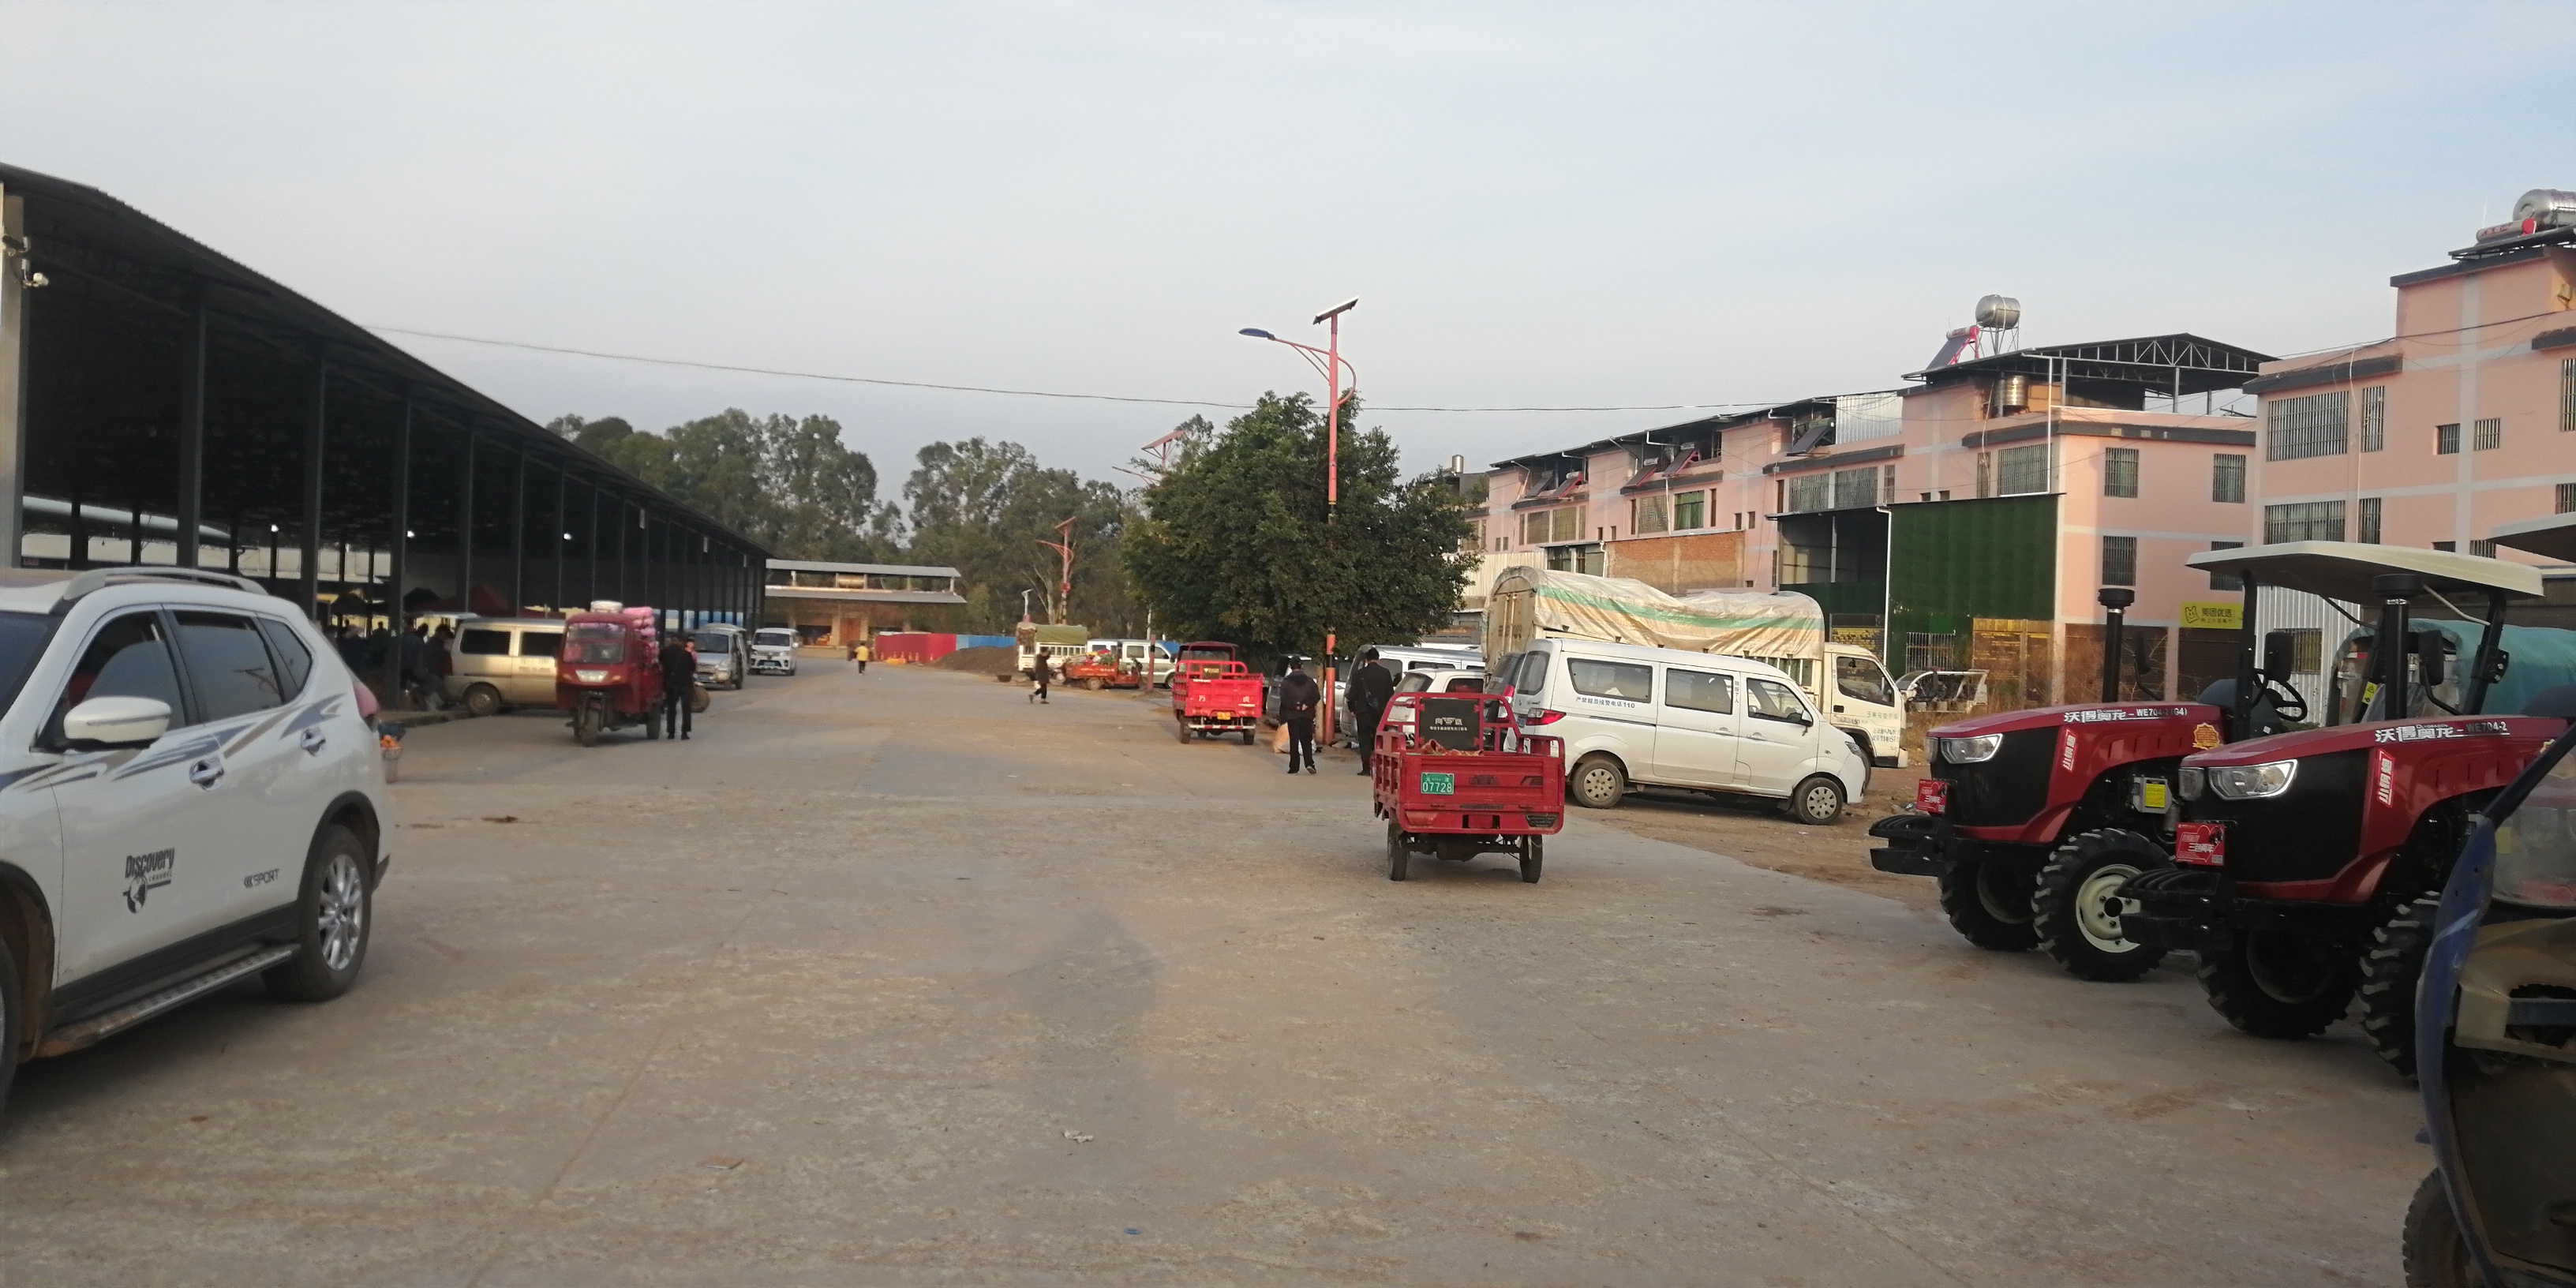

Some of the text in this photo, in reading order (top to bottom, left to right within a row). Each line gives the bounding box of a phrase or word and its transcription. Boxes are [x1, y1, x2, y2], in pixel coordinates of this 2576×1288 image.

[2201, 608, 2233, 617] 美团优选
[2064, 710, 2126, 724] 沃得奥龙
[2375, 725, 2454, 743] 沃得奥龙
[1422, 781, 1453, 793] 07728
[252, 868, 280, 887] SPORT
